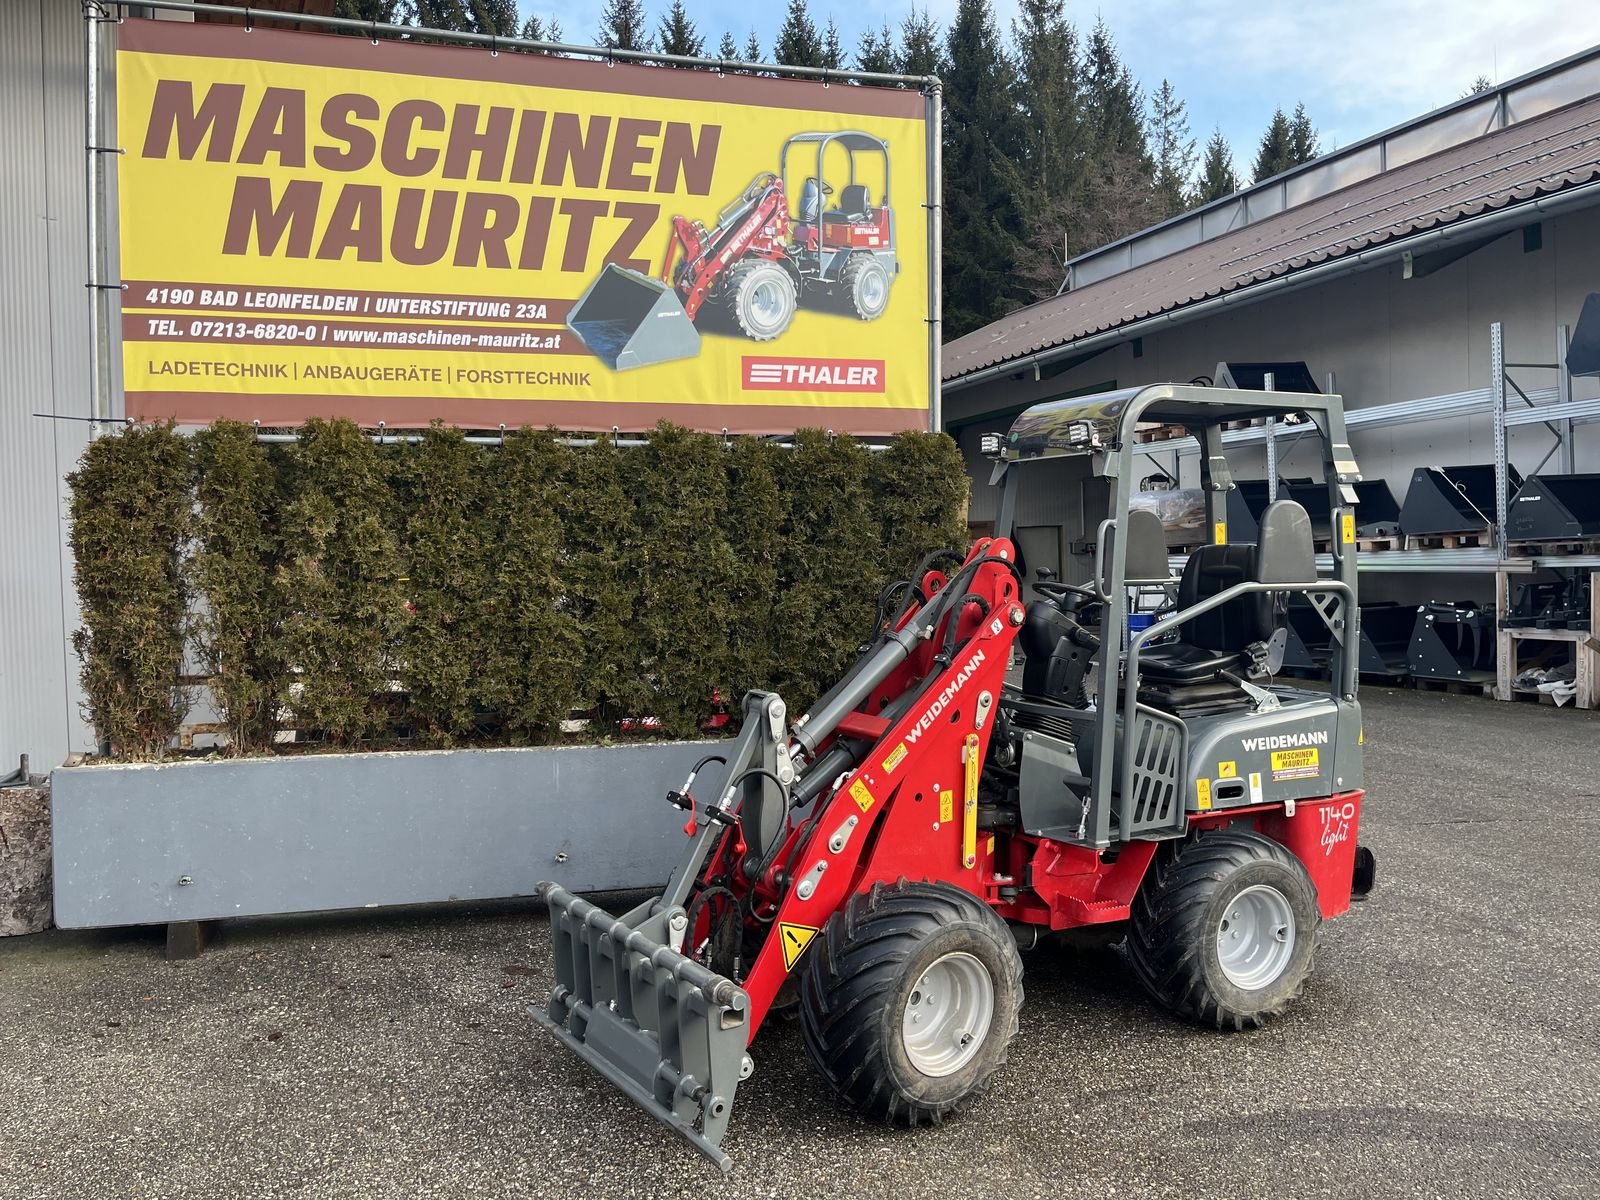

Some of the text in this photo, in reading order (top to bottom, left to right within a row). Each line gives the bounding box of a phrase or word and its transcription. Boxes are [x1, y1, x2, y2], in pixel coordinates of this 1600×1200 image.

[142, 79, 722, 196] MASCHINEN
[222, 175, 661, 274] MAURITZ
[145, 288, 548, 319] 4190 BAD LEONFELDEN UNTERSTIFTUNG 23A
[148, 320, 561, 349] TEL. 07213-6820-0 www.maschinen-mauritz.at
[149, 361, 591, 386] LADETECHNIK ANBAUGERÄTE FORSTTECHNIK
[783, 364, 878, 385] THALER
[905, 649, 986, 744] WEIDEMANN
[1241, 731, 1328, 751] WEIDEMANN
[1276, 750, 1314, 761] MASCHINEN
[1281, 758, 1310, 769] MAURITZ
[1318, 803, 1355, 824] 1140
[1320, 823, 1349, 856] light
